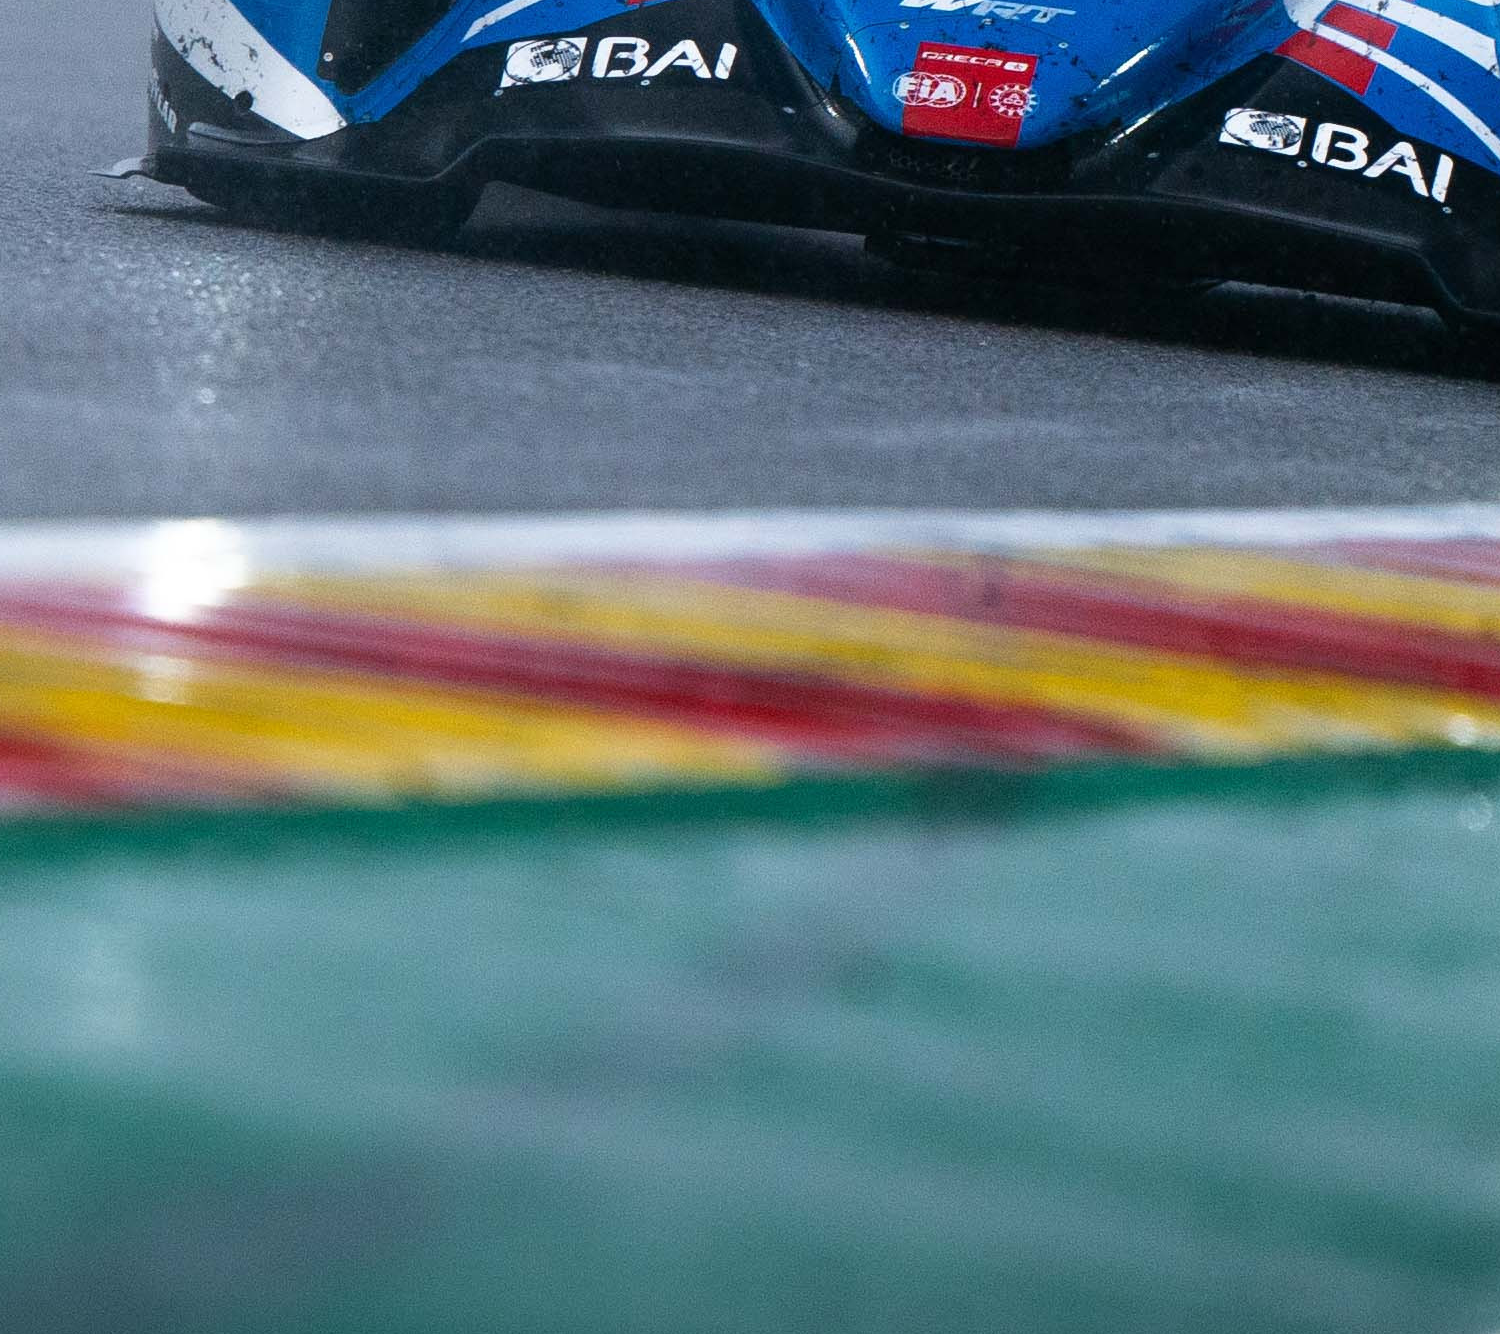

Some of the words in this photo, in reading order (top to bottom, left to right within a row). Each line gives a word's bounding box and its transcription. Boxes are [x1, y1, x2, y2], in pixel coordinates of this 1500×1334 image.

[593, 36, 737, 80] BAI
[920, 51, 1003, 68] ORECA
[1311, 122, 1453, 203] BAI
